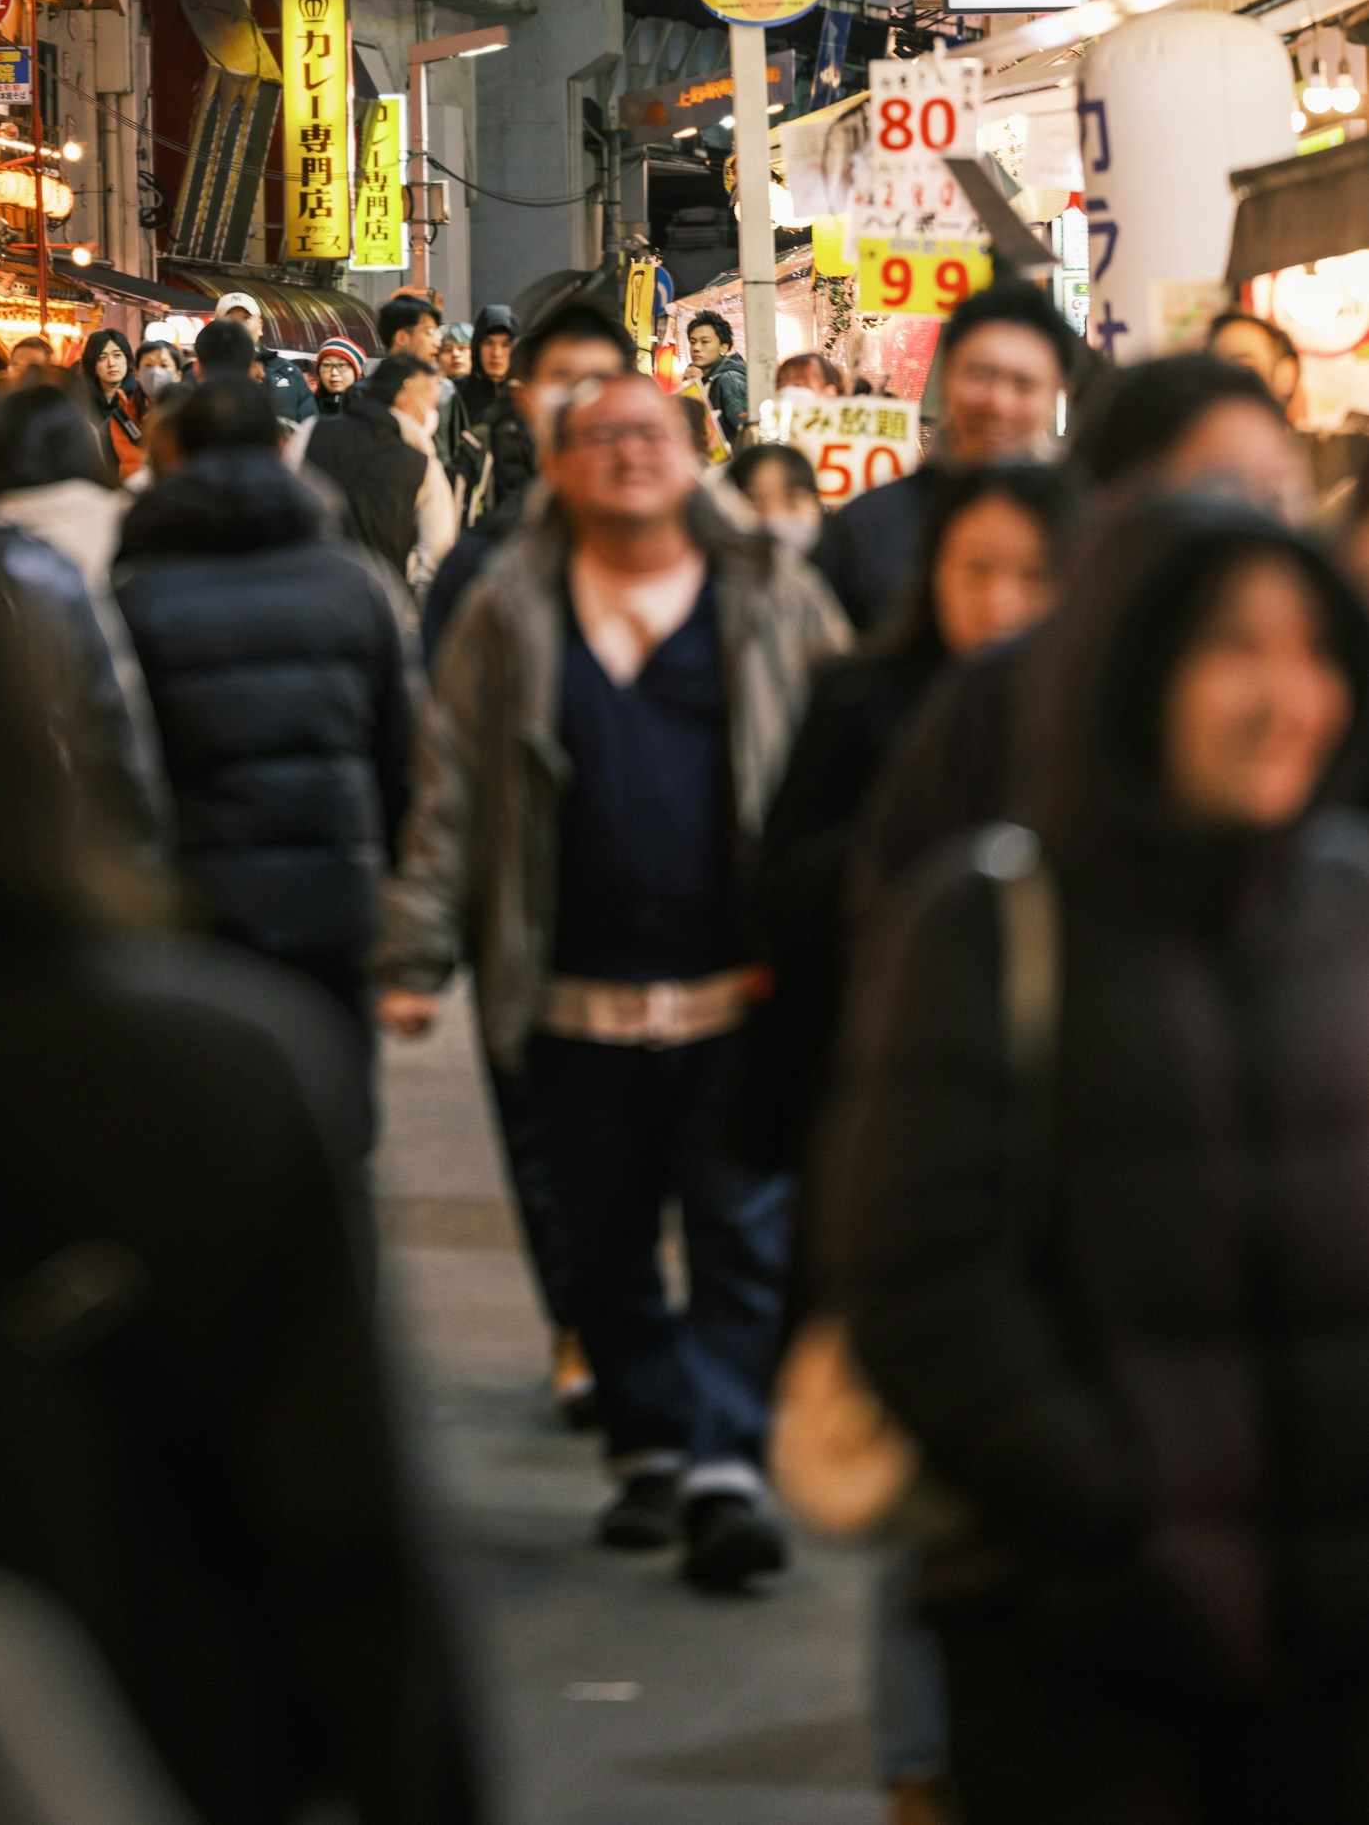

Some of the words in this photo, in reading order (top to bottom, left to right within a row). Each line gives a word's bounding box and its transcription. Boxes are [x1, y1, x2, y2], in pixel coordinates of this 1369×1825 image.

[297, 30, 334, 220] カレー専門店
[879, 97, 956, 151] 80
[296, 235, 341, 252] エース
[881, 257, 972, 311] 99
